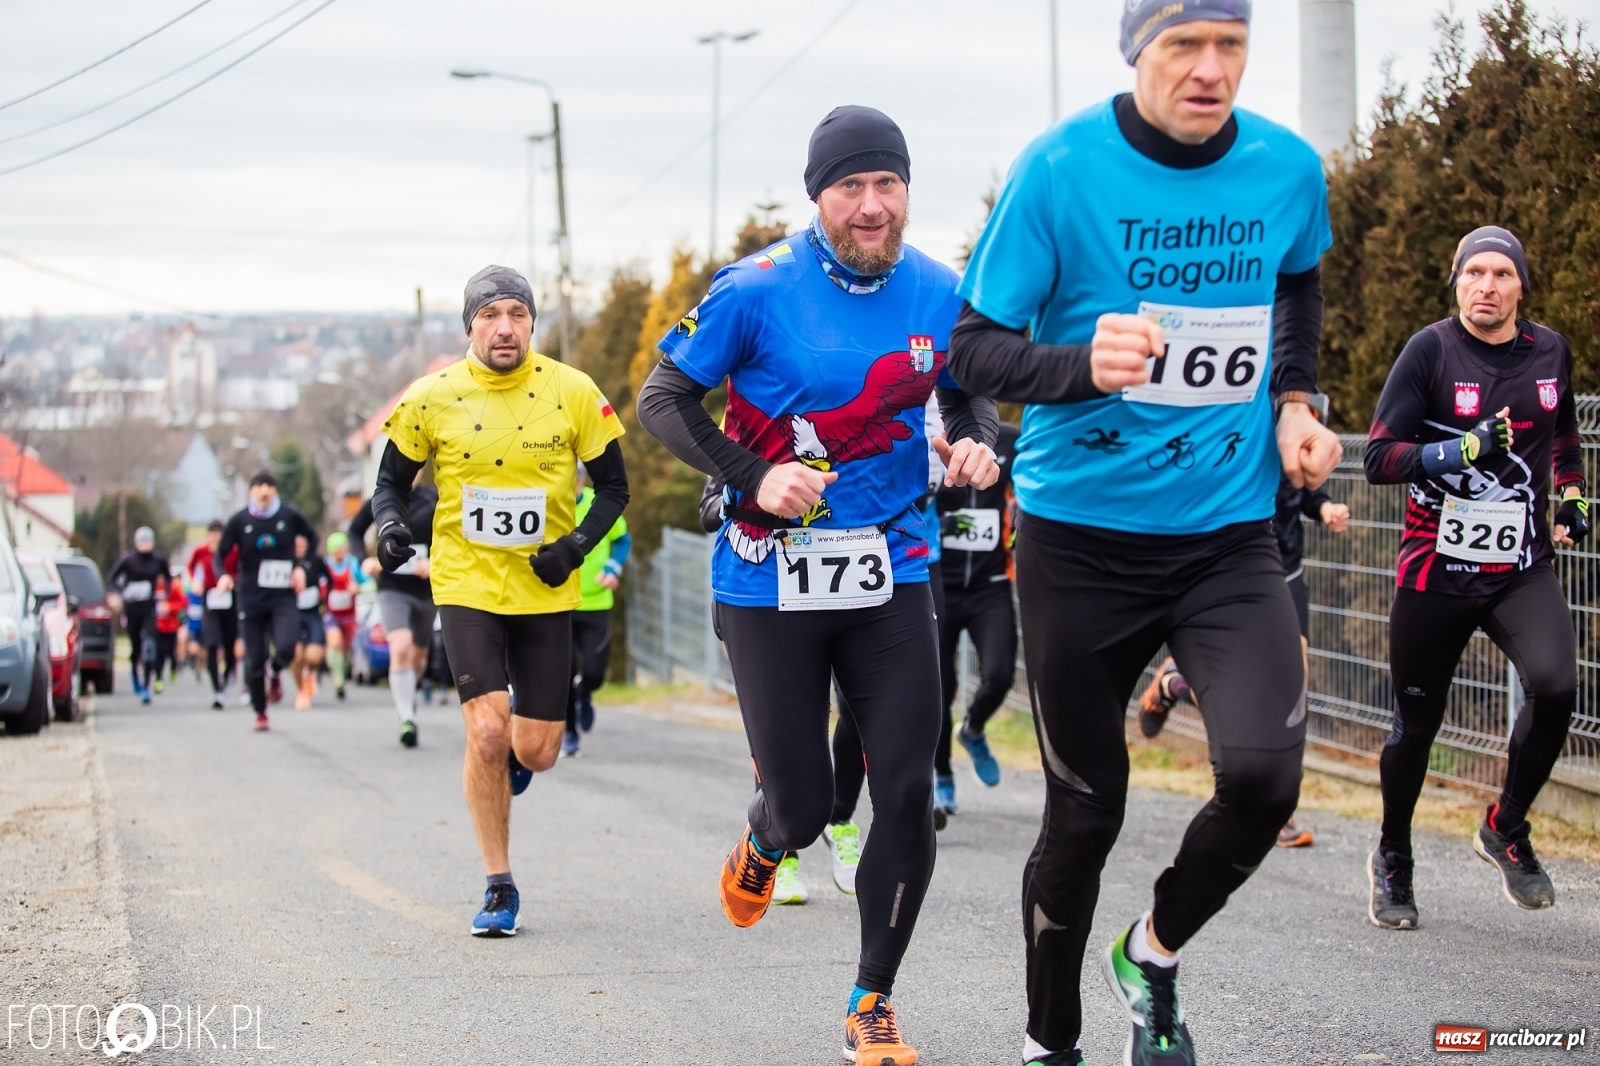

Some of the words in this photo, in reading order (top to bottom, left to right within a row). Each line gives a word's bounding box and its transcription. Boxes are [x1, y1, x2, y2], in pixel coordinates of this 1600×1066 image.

[1117, 215, 1264, 251] Triathlon
[1128, 252, 1262, 293] Gogolin
[1147, 343, 1258, 388] 166
[469, 507, 540, 536] 130
[817, 532, 882, 544] www.personalbest.pl
[956, 525, 993, 542] 64
[1443, 519, 1518, 551] 326
[788, 554, 886, 594] 173
